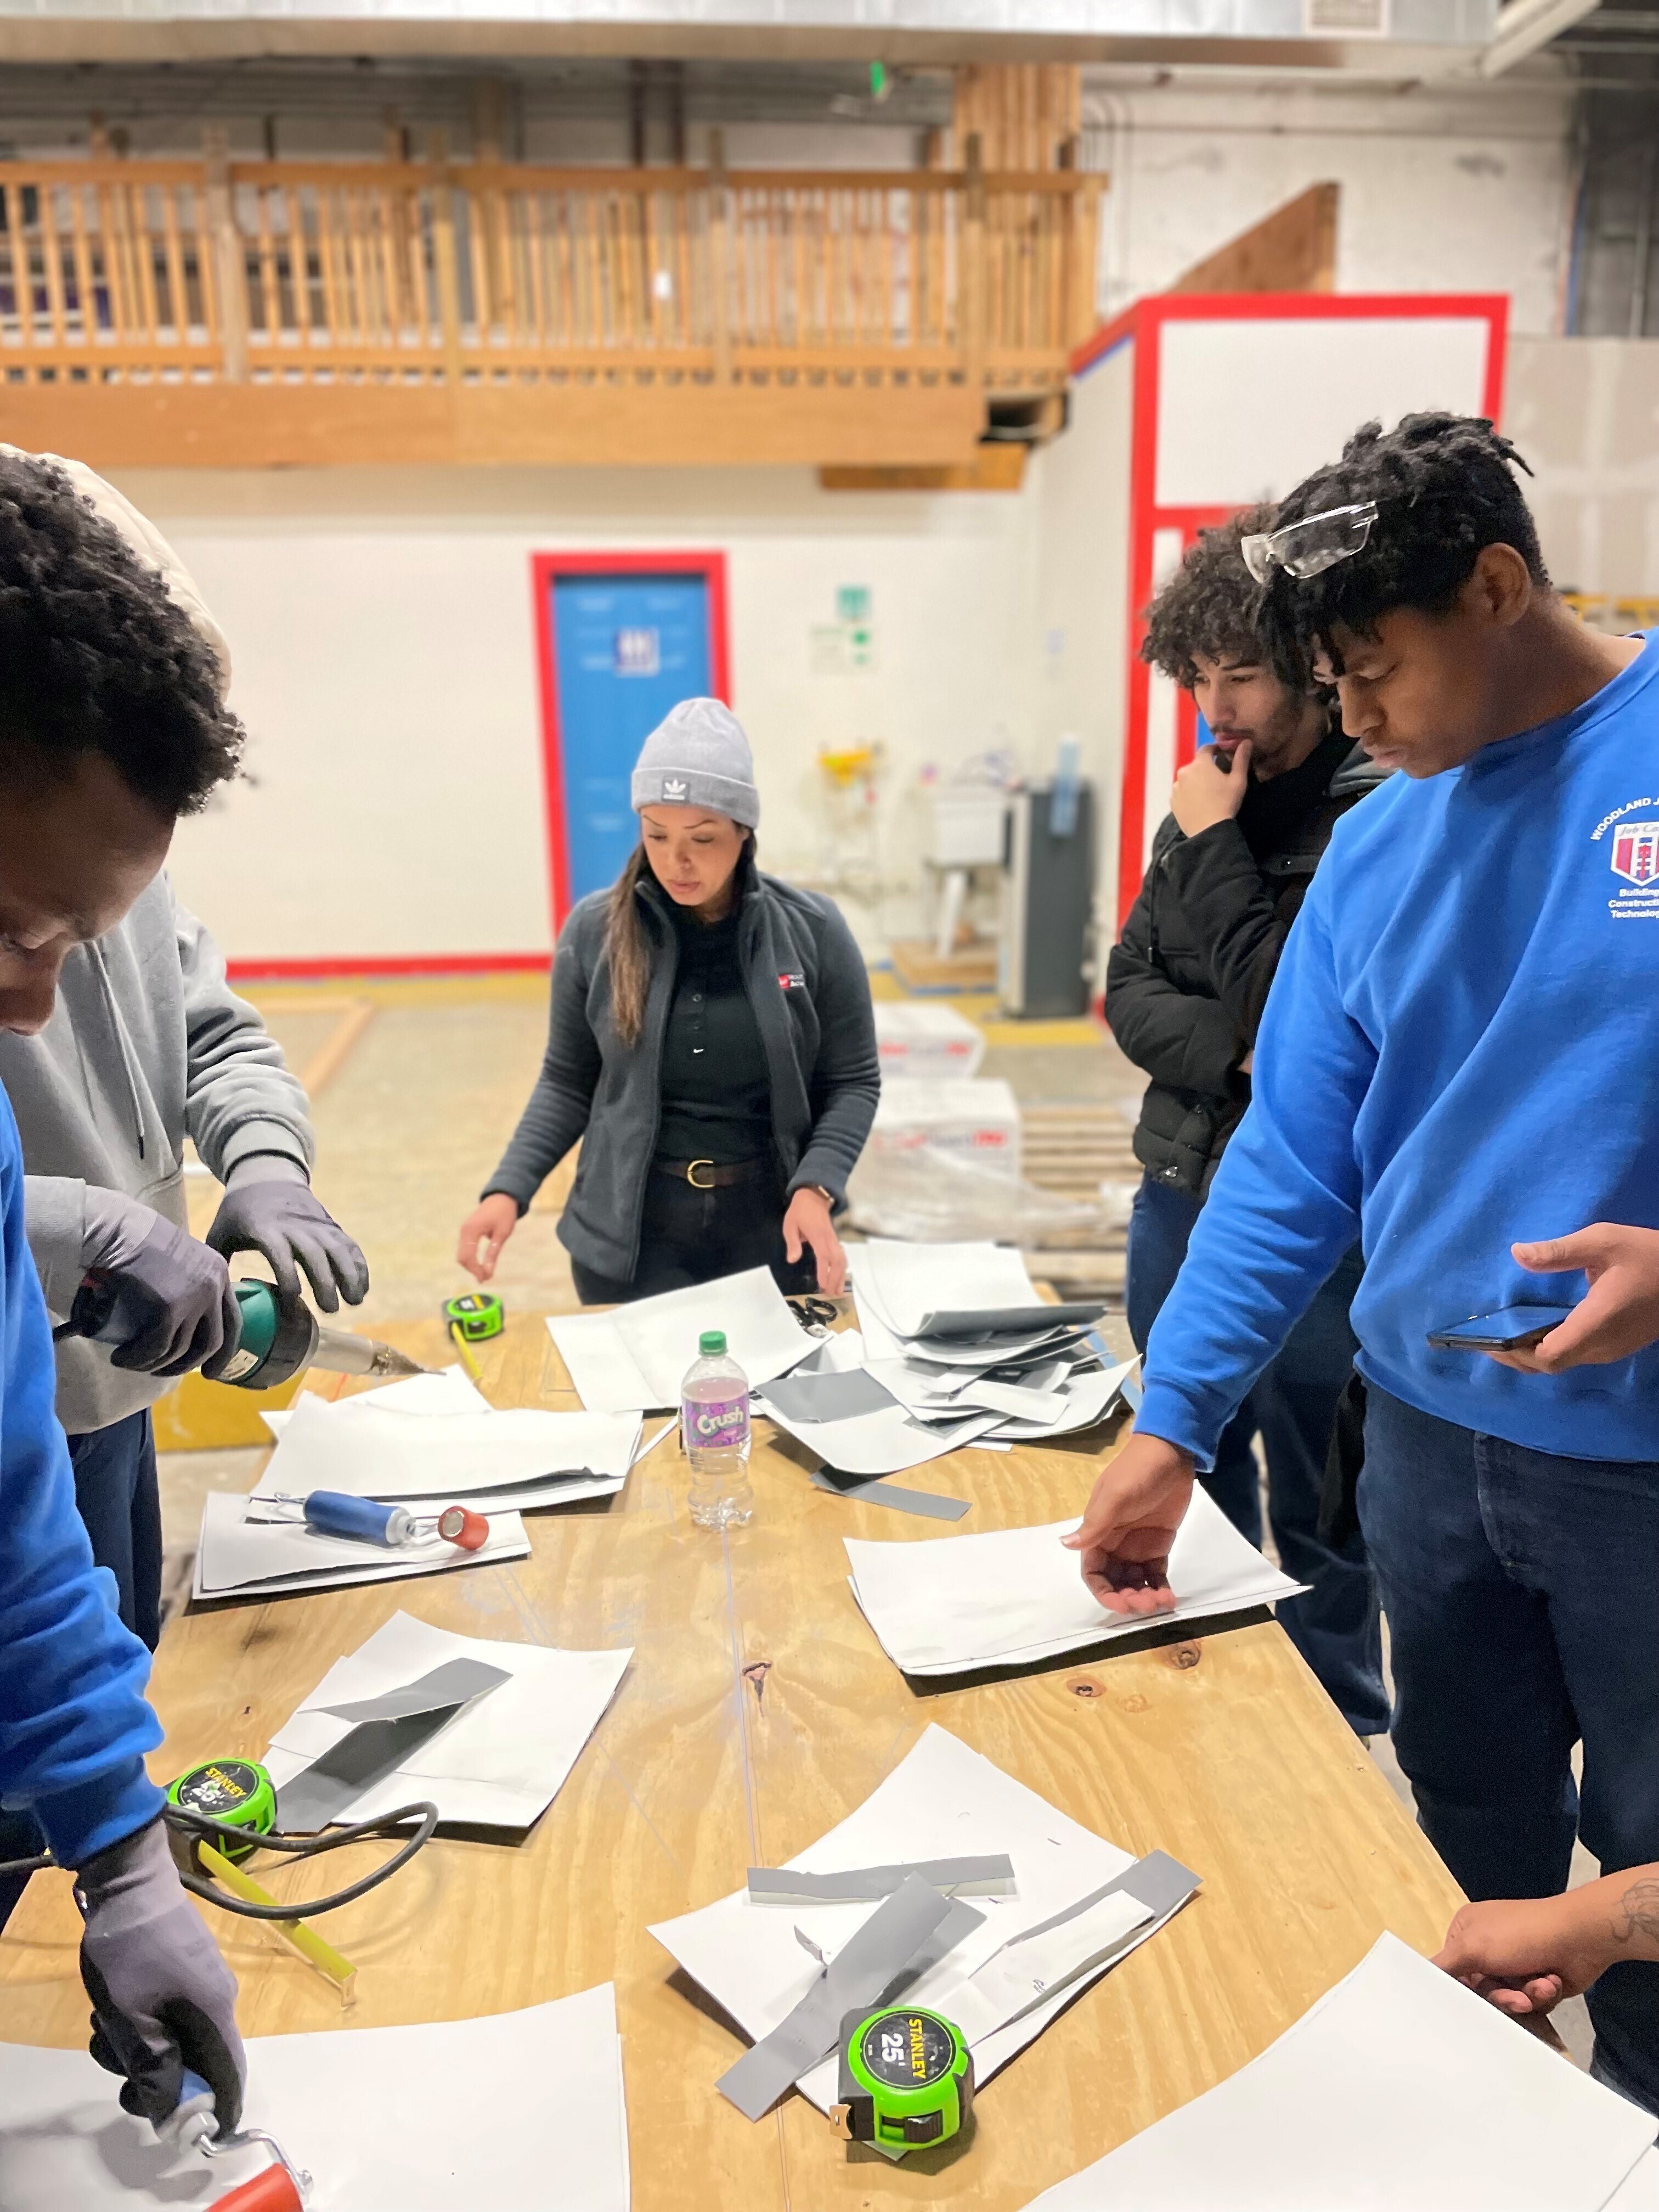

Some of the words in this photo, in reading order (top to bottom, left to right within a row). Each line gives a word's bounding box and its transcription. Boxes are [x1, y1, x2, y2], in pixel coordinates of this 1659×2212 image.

[1590, 797, 1651, 840] WOODLAND
[1619, 825, 1639, 837] Job
[1619, 888, 1659, 897] Building
[697, 1406, 744, 1434] Crush
[205, 1767, 247, 1798] STANLEY
[881, 2033, 905, 2067] 25'
[909, 2018, 927, 2079] STANLEY
